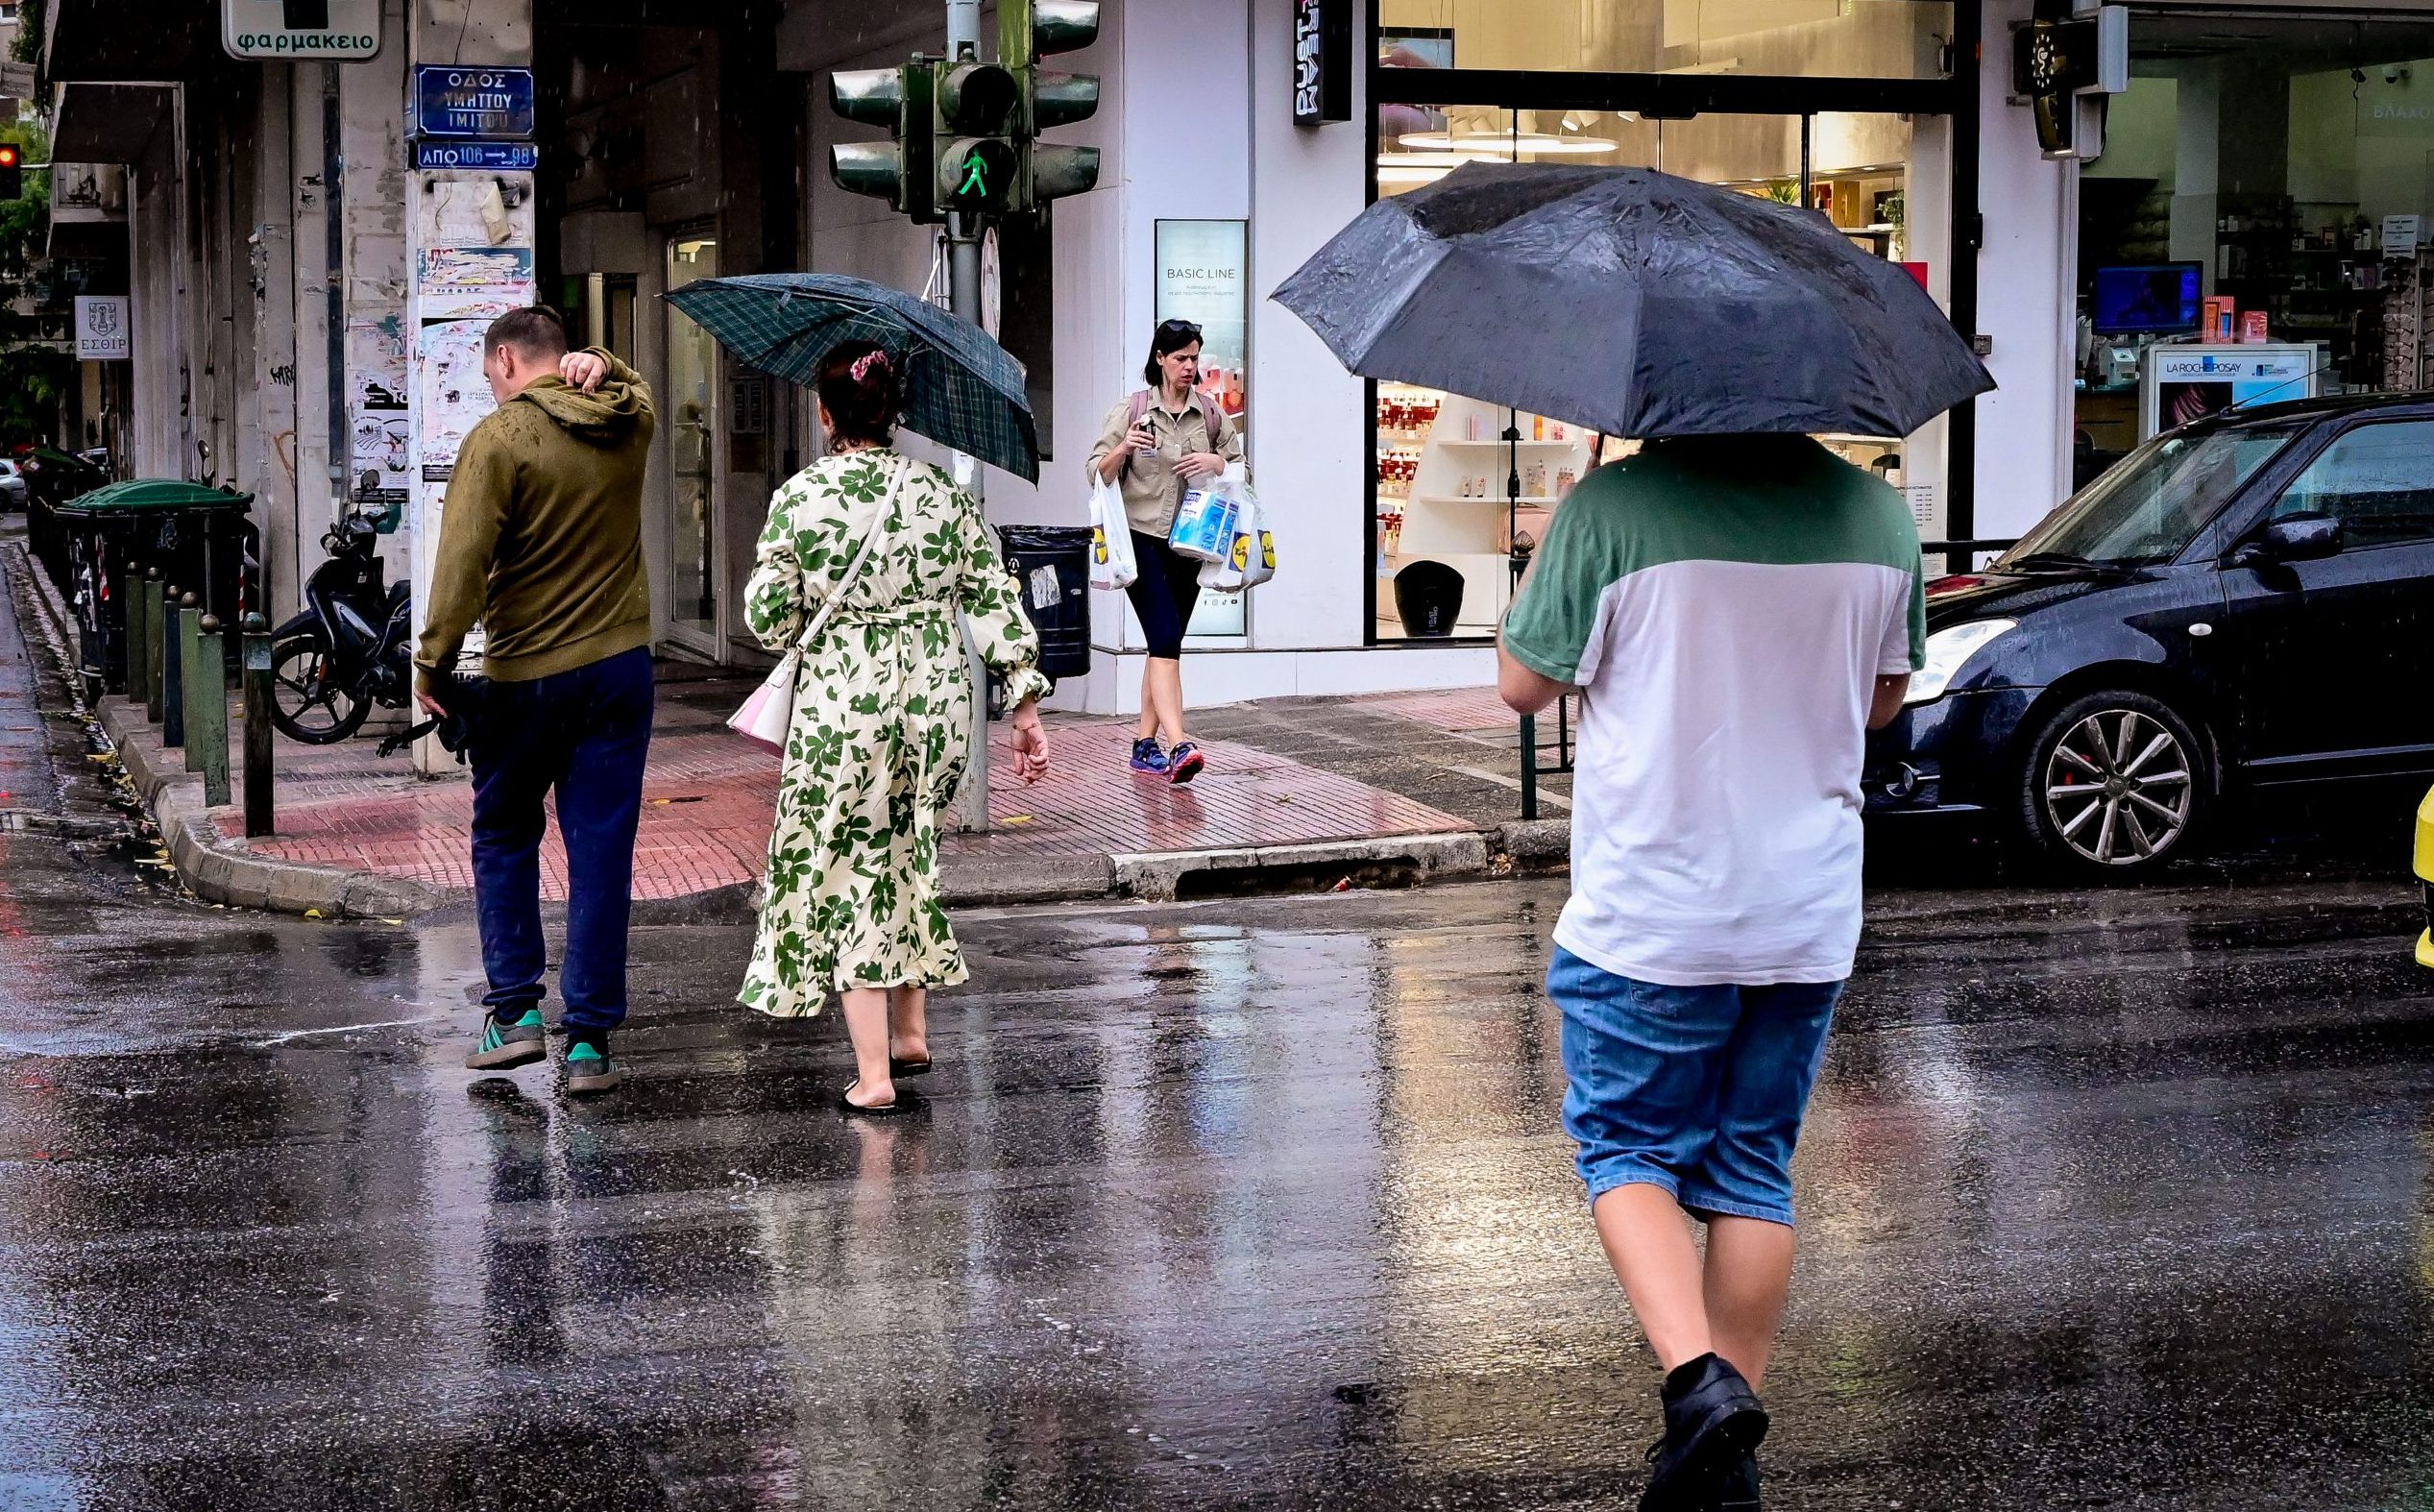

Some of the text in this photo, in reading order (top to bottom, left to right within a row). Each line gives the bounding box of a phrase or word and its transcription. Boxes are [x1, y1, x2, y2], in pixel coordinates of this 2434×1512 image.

[237, 34, 374, 52] φαρμακειο
[1306, 0, 1319, 114] REAM
[449, 73, 505, 88] ΟΔΟΣ
[445, 92, 512, 109] ΥΜΗΤΤΟΥ
[423, 146, 529, 166] ΑΠΟ 106 98
[1167, 268, 1235, 279] BASIC LINE
[2166, 363, 2178, 373] LA
